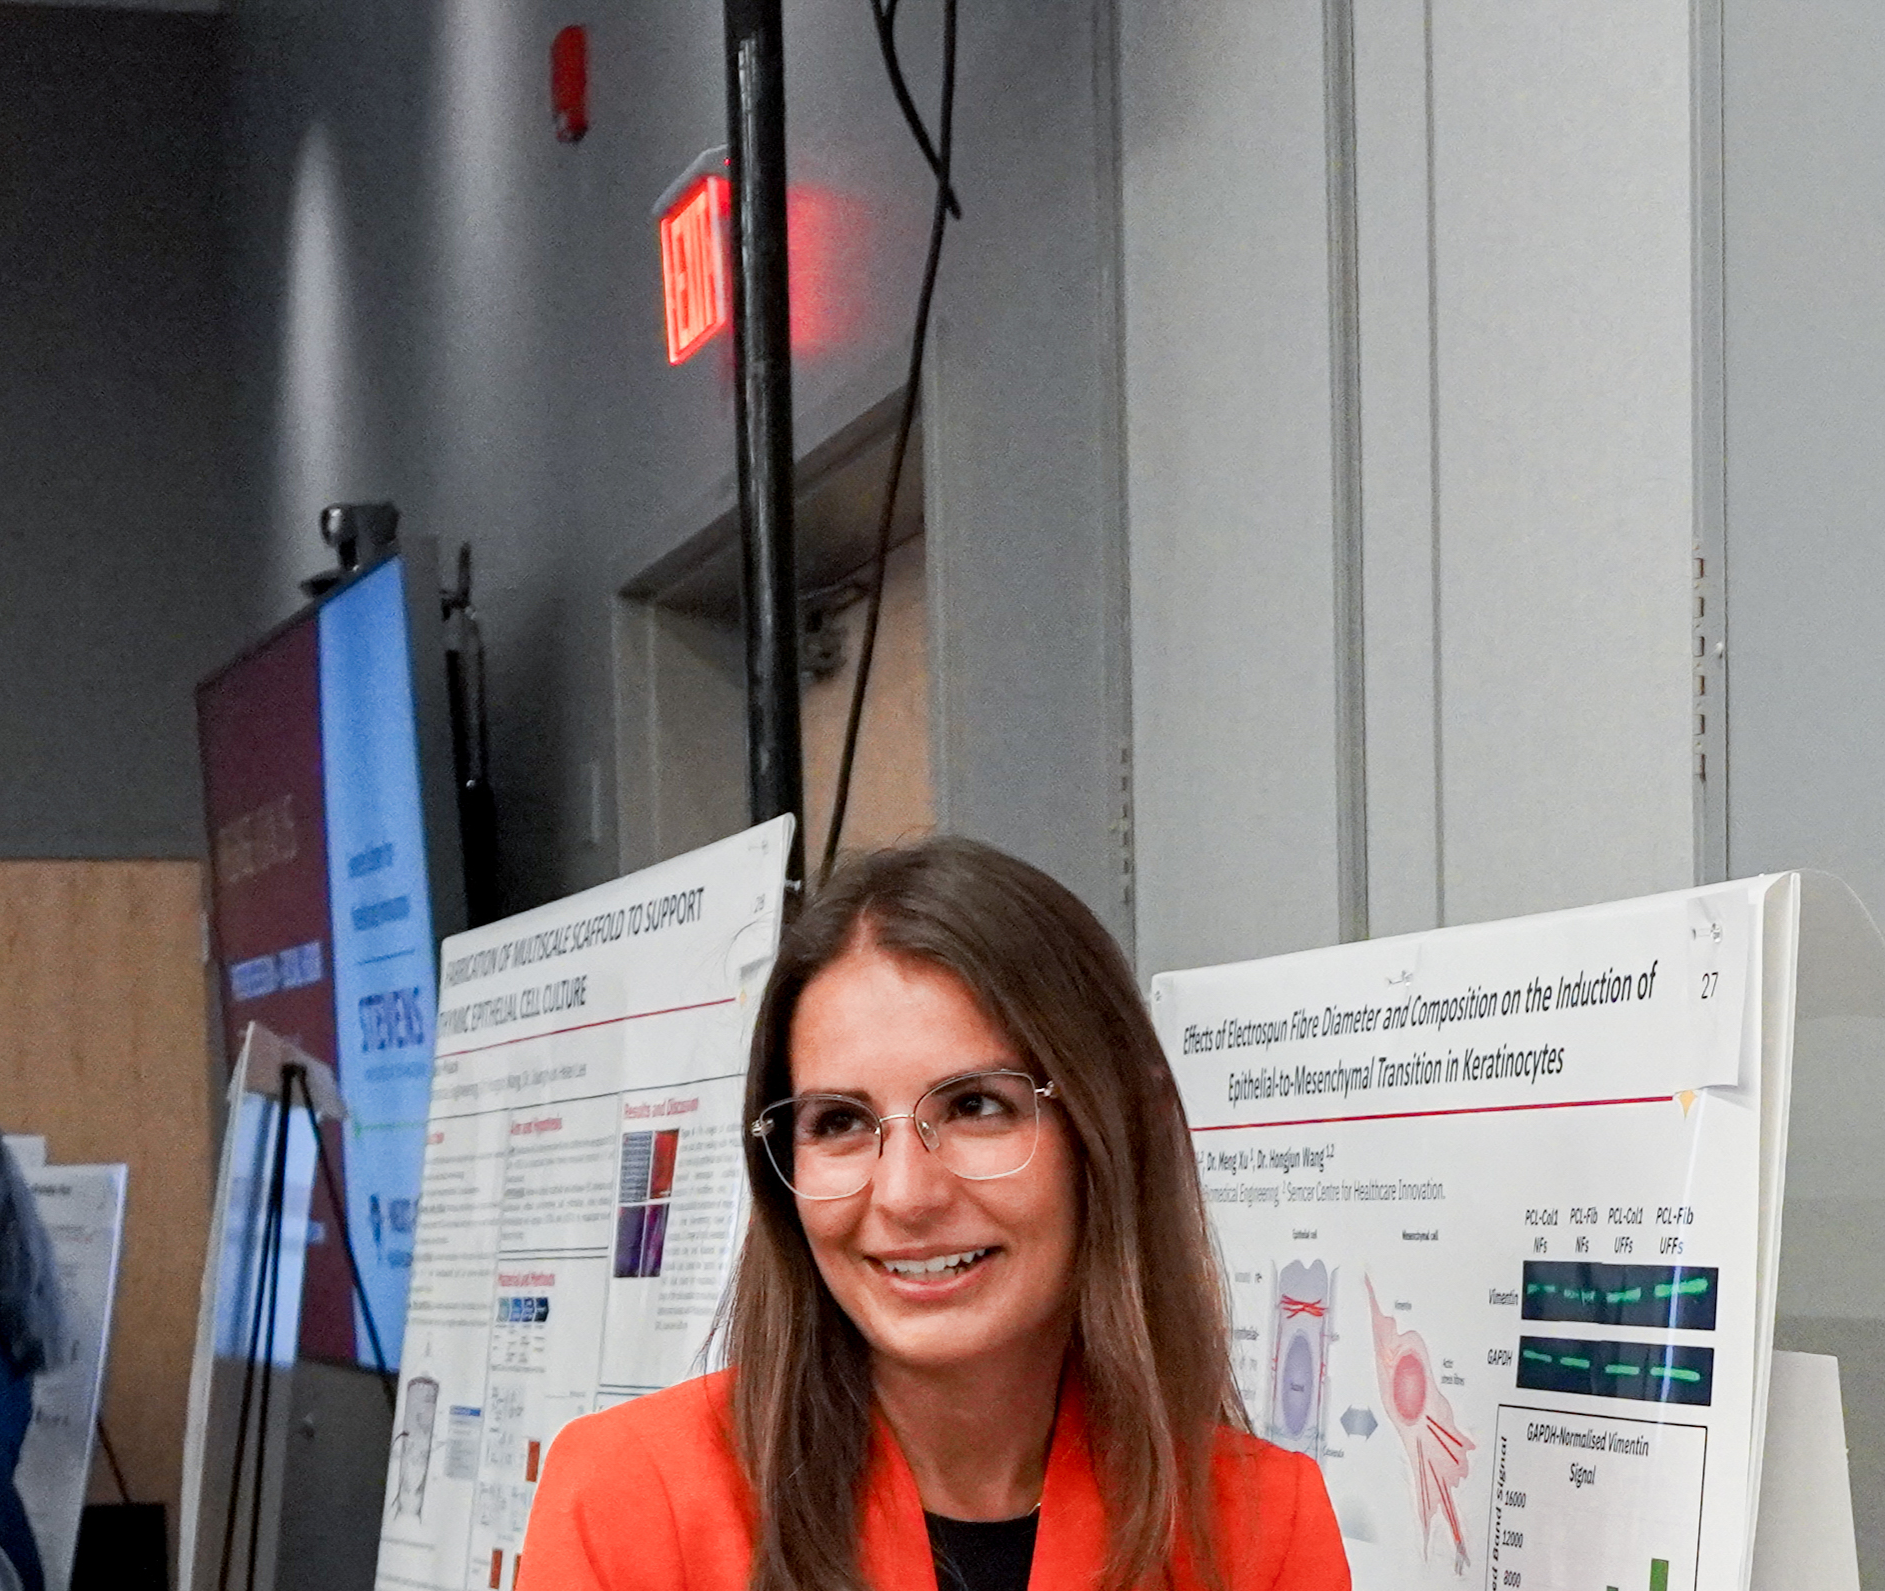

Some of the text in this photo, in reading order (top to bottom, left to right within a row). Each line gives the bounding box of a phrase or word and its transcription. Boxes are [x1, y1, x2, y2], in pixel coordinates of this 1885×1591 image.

[570, 908, 624, 952] SCAFFOLD
[627, 905, 640, 937] TO
[644, 886, 705, 932] SUPPORT
[520, 988, 541, 1020] CELL
[542, 974, 587, 1014] CULTURE
[1700, 971, 1719, 1000] 27
[1183, 959, 1659, 1056] Effects of Electrospun Fibre Diameter and Composition on the Induction of
[1228, 1043, 1565, 1108] Epithelial-to-Mesenchymal Transition in Keratinocytes
[1302, 1147, 1325, 1172] Wang
[1354, 1179, 1446, 1201] Healthcare Innovation.
[1569, 1206, 1598, 1225] PCL-Fib
[1655, 1206, 1694, 1225] PCL-Fib
[1614, 1236, 1683, 1255] UFFs UFFs
[1487, 1348, 1513, 1366] GAPDH
[1526, 1422, 1650, 1457] GAPDH-Normalised Vimentin
[1569, 1462, 1596, 1489] Signal
